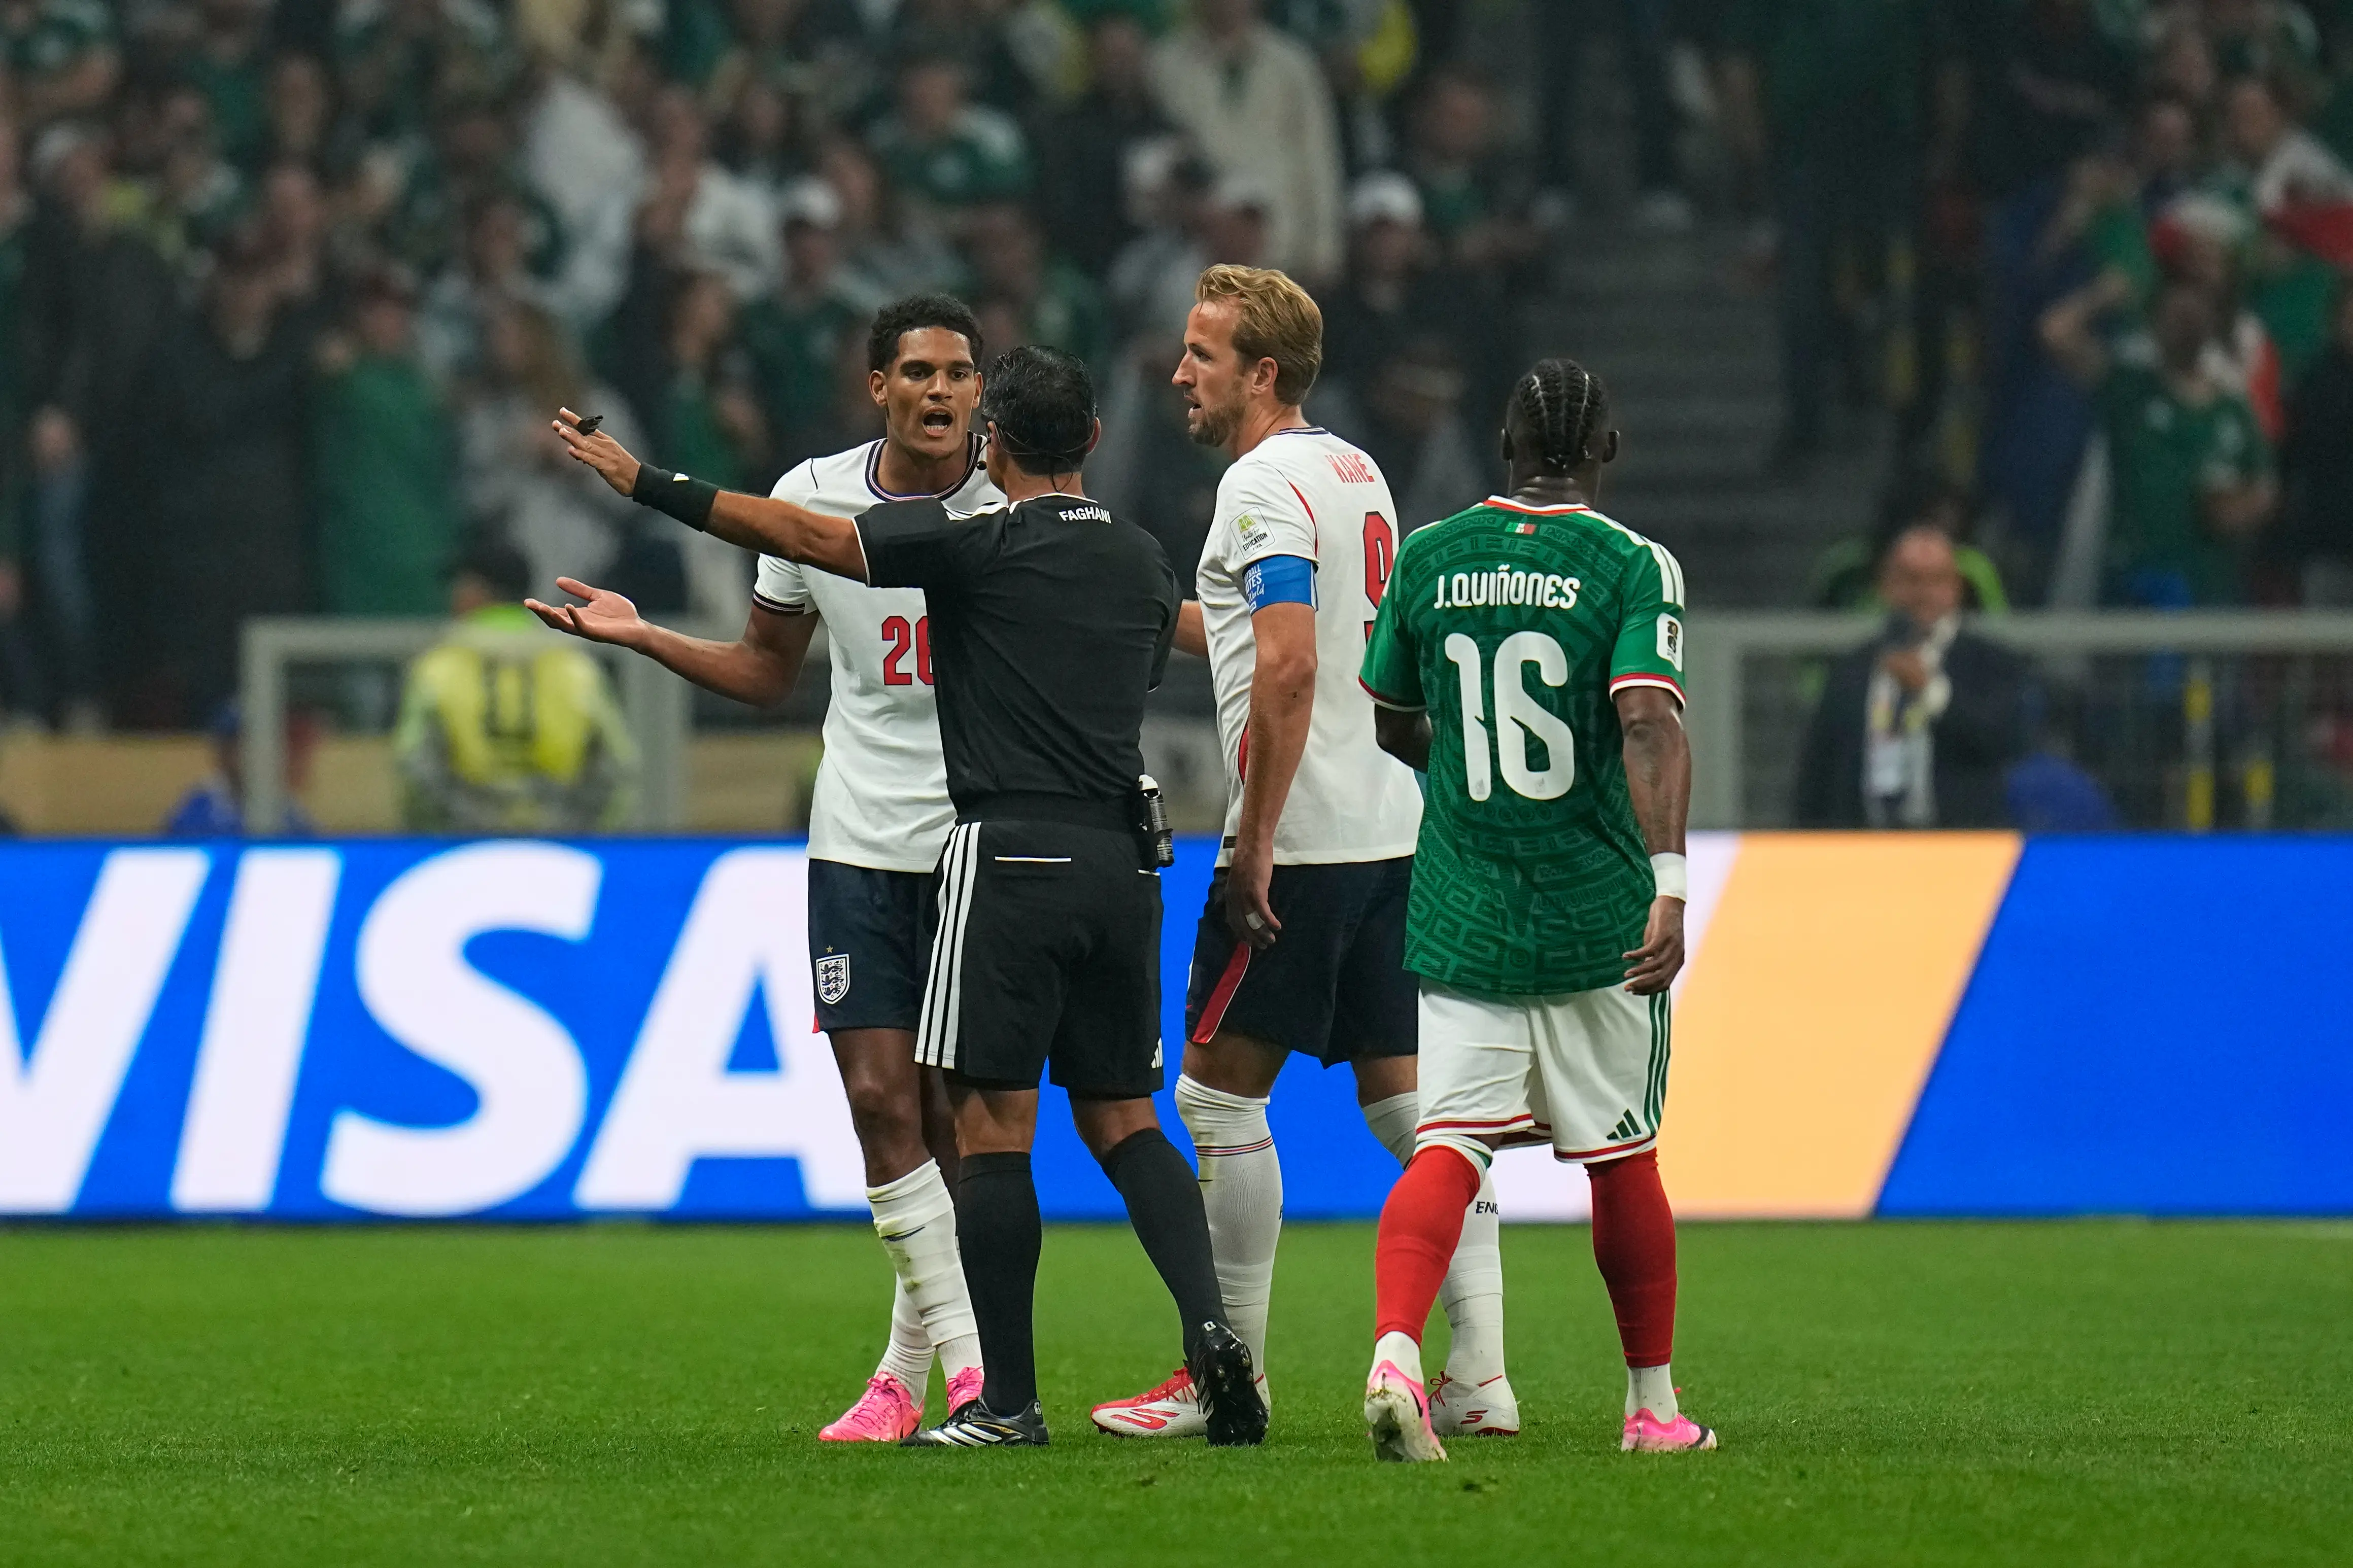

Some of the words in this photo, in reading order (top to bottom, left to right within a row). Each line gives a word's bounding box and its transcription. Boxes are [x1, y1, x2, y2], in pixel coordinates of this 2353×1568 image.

[1324, 454, 1375, 483] KANE
[1059, 506, 1111, 524] FAGHANI
[1243, 532, 1268, 551] EDUCATION
[1434, 564, 1581, 609] J.QUIÑONES
[1445, 631, 1575, 802] 16
[0, 840, 869, 1217] VISA
